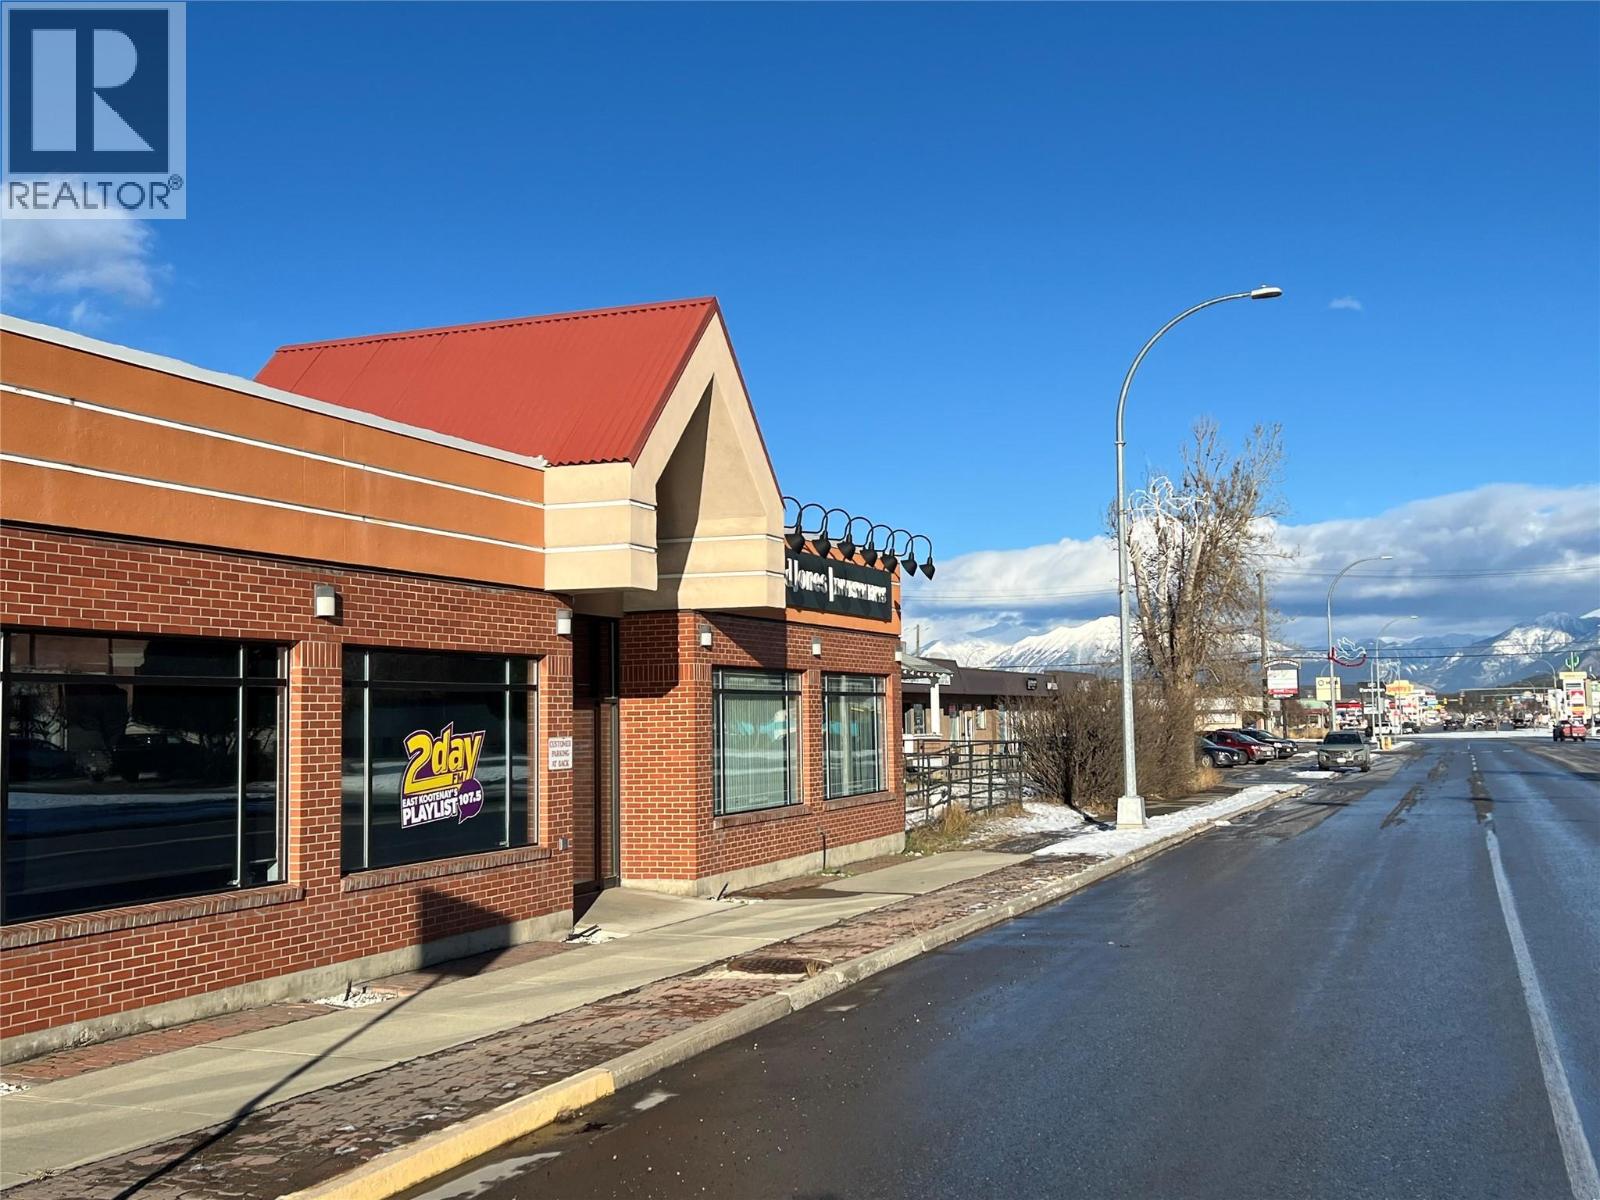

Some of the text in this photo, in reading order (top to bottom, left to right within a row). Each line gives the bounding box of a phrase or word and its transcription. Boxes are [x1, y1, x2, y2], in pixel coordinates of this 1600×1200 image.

[793, 559, 828, 594] Jones
[549, 740, 572, 749] CUSTOMER
[551, 749, 570, 758] PARKING
[404, 728, 482, 794] 2day
[453, 770, 467, 784] FM
[402, 788, 458, 808] EAST KOOTENAY'S
[458, 790, 482, 806] 107.5
[402, 797, 458, 826] PLAYLIST
